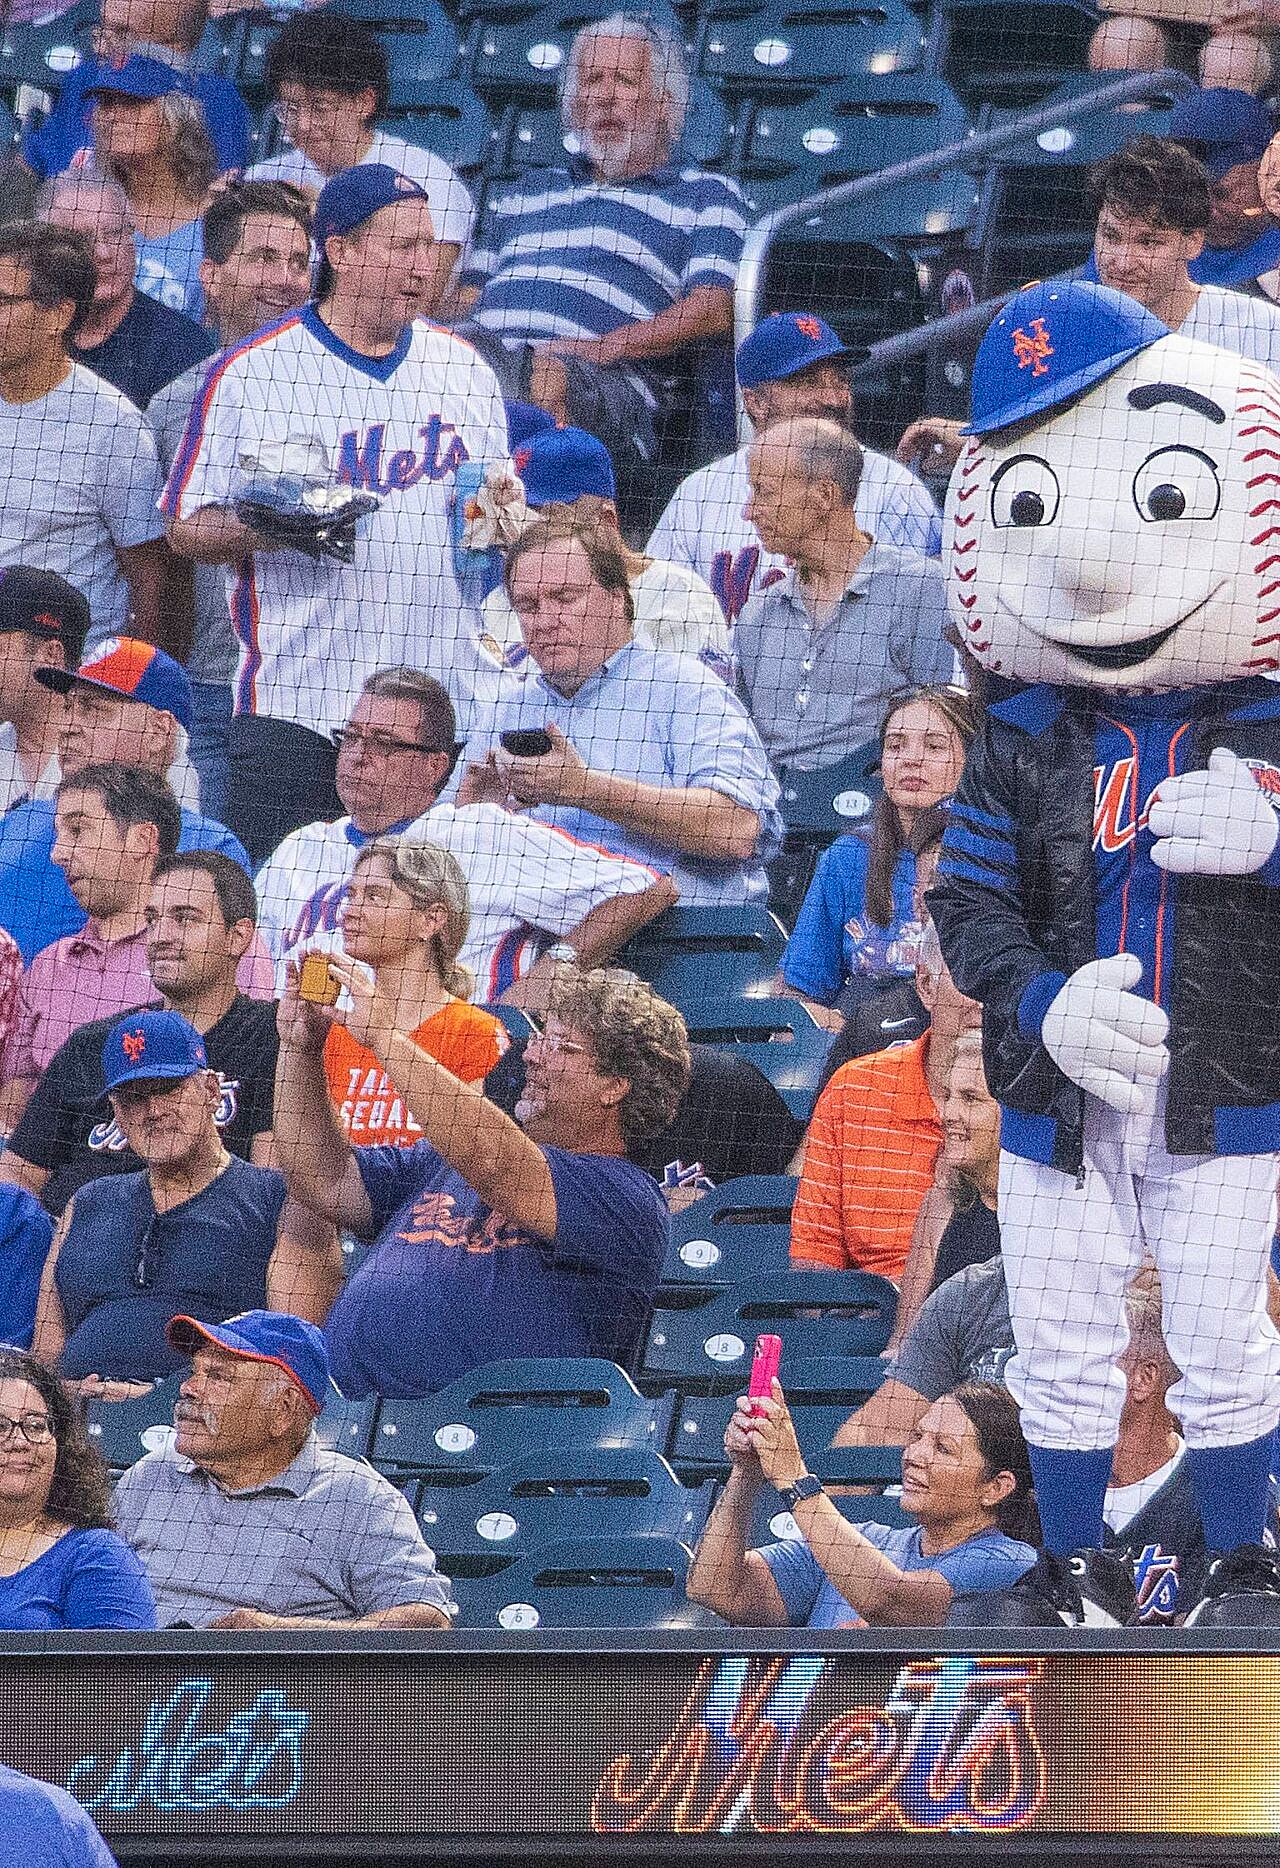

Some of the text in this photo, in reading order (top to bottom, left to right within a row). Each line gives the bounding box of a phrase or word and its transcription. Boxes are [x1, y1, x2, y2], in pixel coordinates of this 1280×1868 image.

[336, 413, 470, 496] Mets
[694, 1248, 704, 1259] 9
[720, 1342, 729, 1353] 8
[450, 1432, 460, 1443] 8
[785, 1520, 794, 1531] 6
[590, 1655, 1048, 1833] Mets
